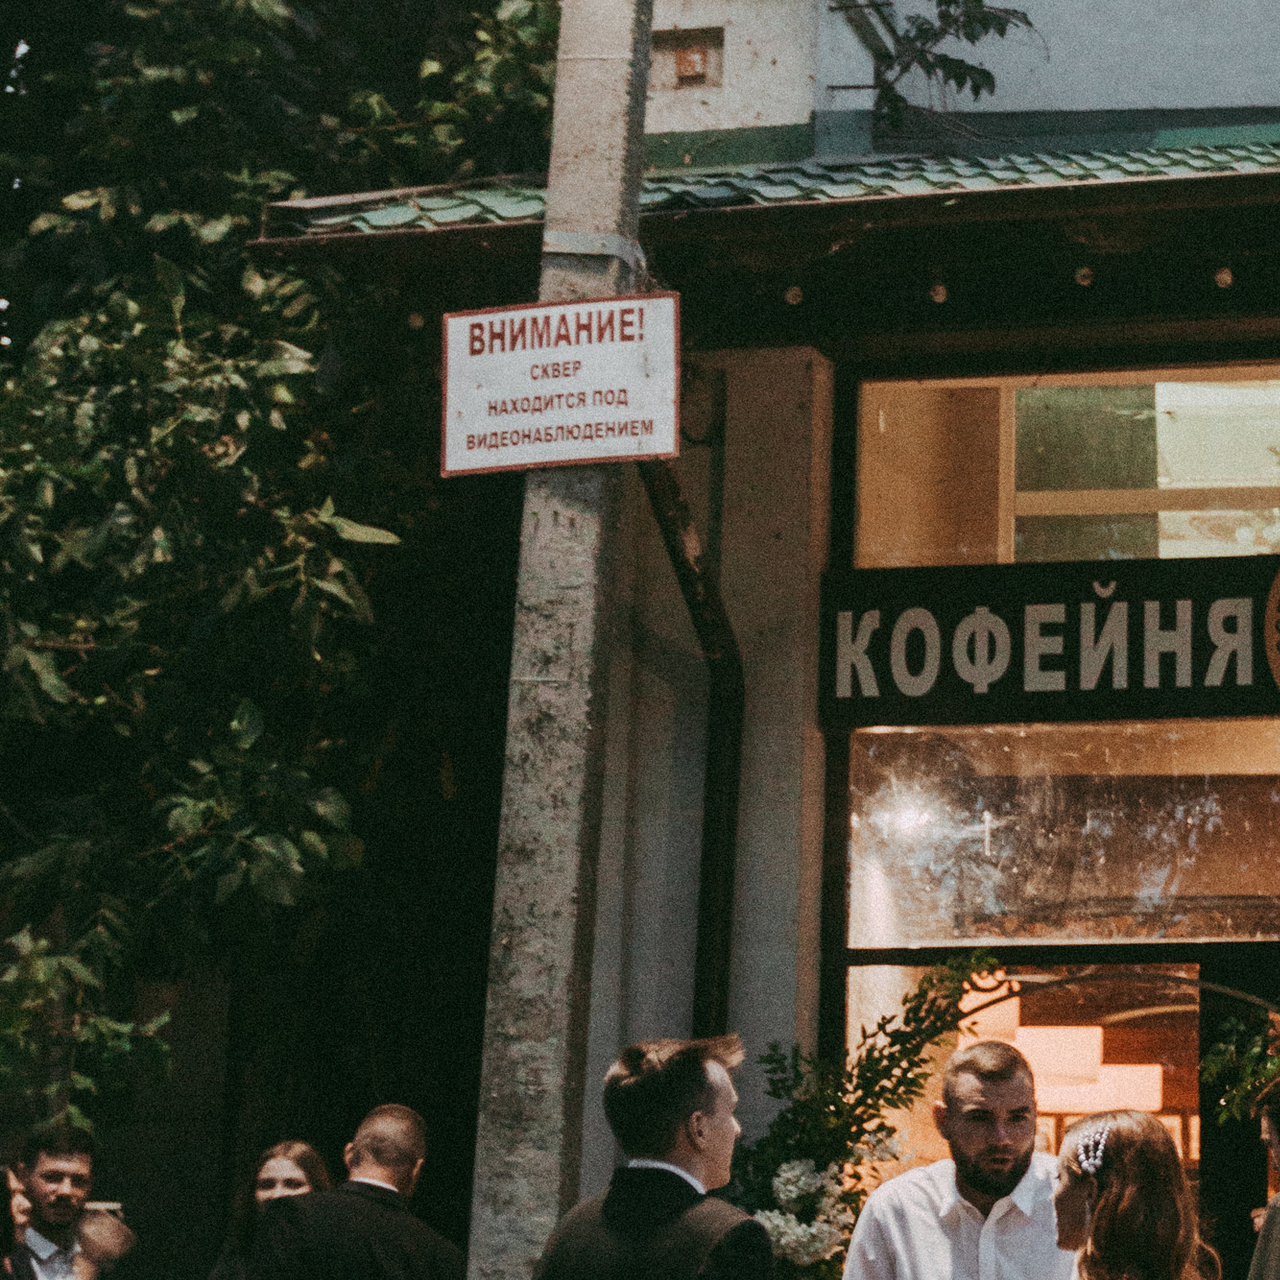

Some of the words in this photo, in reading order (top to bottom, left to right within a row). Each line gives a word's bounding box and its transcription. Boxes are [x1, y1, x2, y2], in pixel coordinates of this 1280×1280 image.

[468, 308, 645, 356] ВНИМАНИЕ!
[530, 361, 582, 380] СКВЕР
[487, 391, 587, 417] НАХОДИТСЯ
[592, 389, 629, 408] ПОД
[466, 419, 654, 451] ВИДЕОНАБЛЮДЕНИЕМ
[835, 581, 1254, 698] КОФЕЙНЯ
